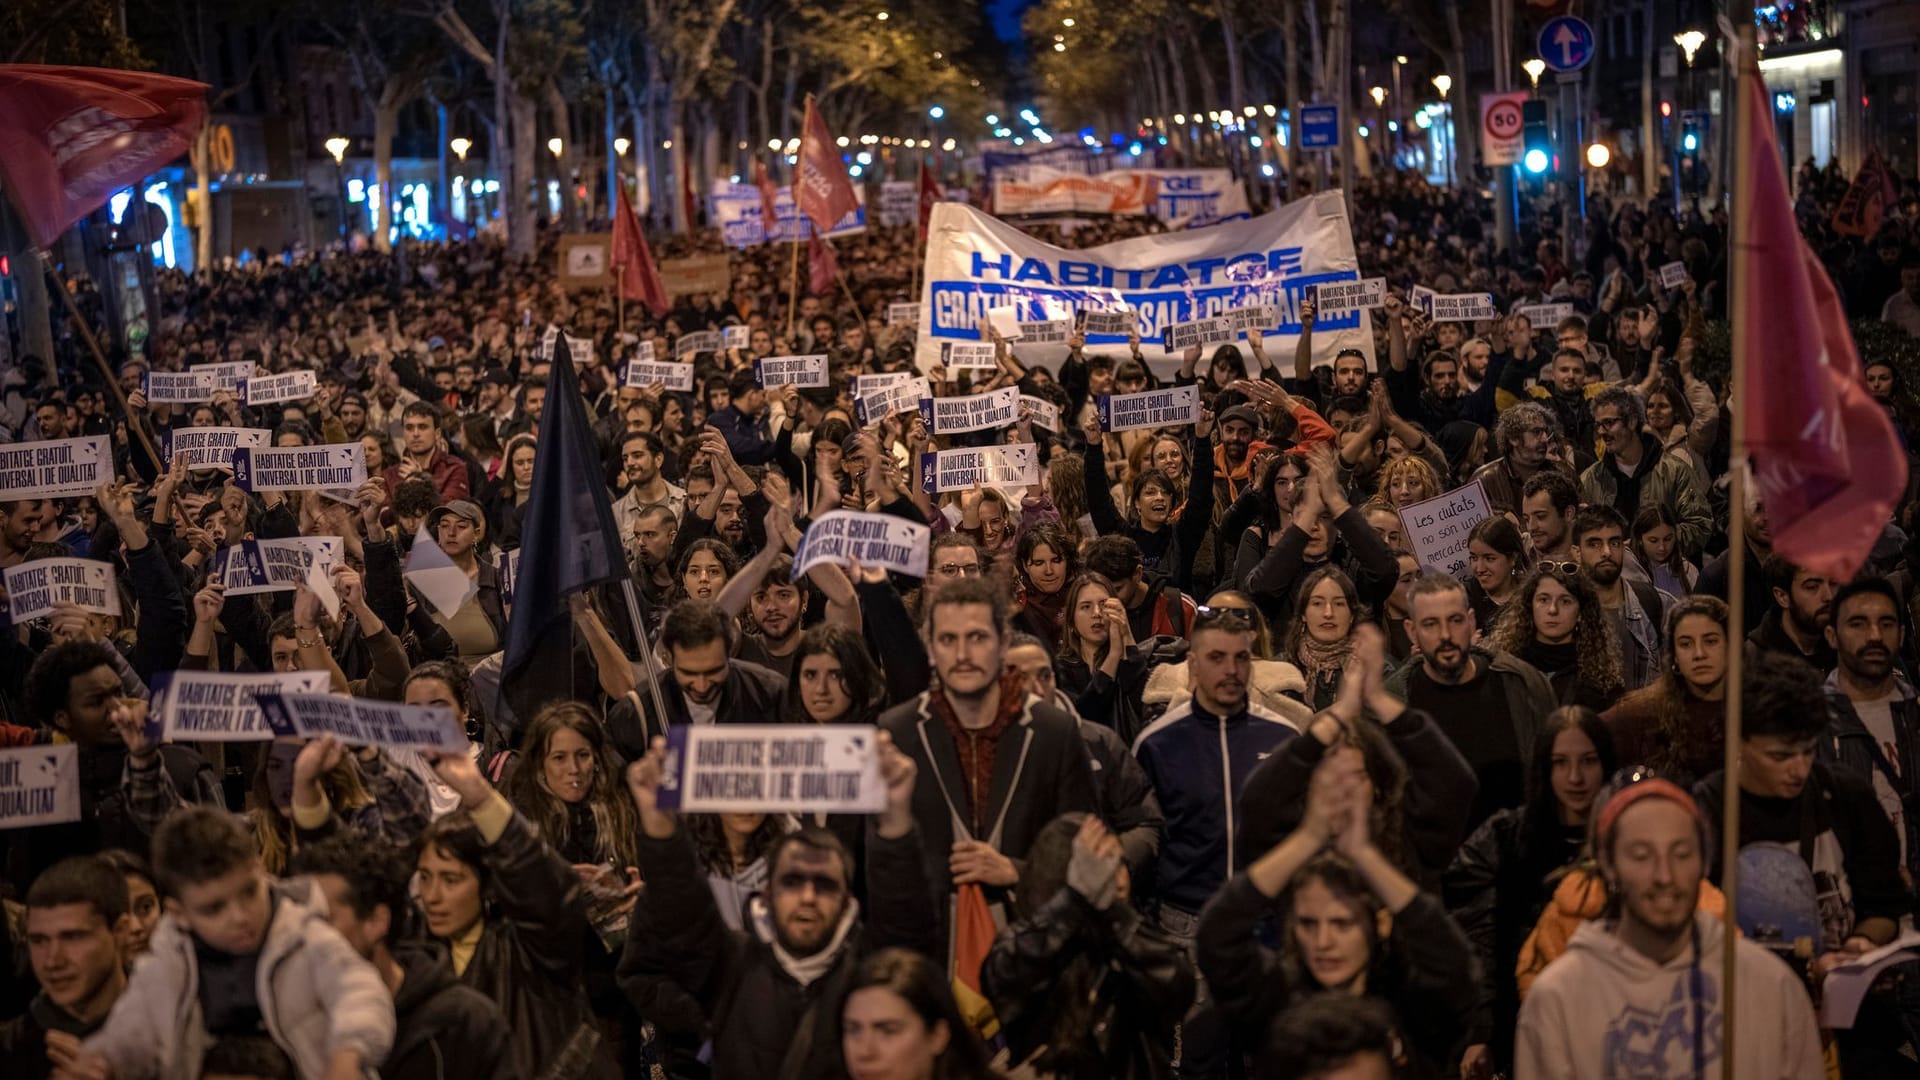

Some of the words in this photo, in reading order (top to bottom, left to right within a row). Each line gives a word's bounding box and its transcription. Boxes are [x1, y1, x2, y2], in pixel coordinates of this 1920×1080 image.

[1495, 113, 1517, 127] 50
[971, 247, 1303, 288] HABITATGE
[937, 403, 967, 415] HABITATGE
[1114, 397, 1146, 413] HABITATGE
[938, 415, 970, 429] UNIVERSAL
[975, 413, 982, 425] DE
[984, 406, 1011, 424] QUALITAT
[1115, 410, 1148, 427] UNIVERSAL
[1153, 409, 1161, 422] DE
[1162, 406, 1190, 421] QUALITAT
[175, 432, 207, 450] HABITATGE
[0, 449, 34, 470] BITATGE
[211, 449, 221, 463] DE
[255, 453, 296, 470] HABITATGE
[941, 453, 976, 471] HABITATGE
[45, 467, 56, 485] DE
[58, 462, 97, 484] QUALITAT
[256, 466, 299, 486] UNIVERSAL
[305, 467, 316, 484] DE
[317, 466, 352, 484] QUALITAT
[941, 469, 977, 487] UNIVERSAL
[1415, 515, 1434, 528] Les
[1438, 495, 1476, 521] ciutats
[1422, 535, 1434, 545] no
[866, 541, 912, 566] QUALITAT
[1427, 538, 1468, 564] mercade
